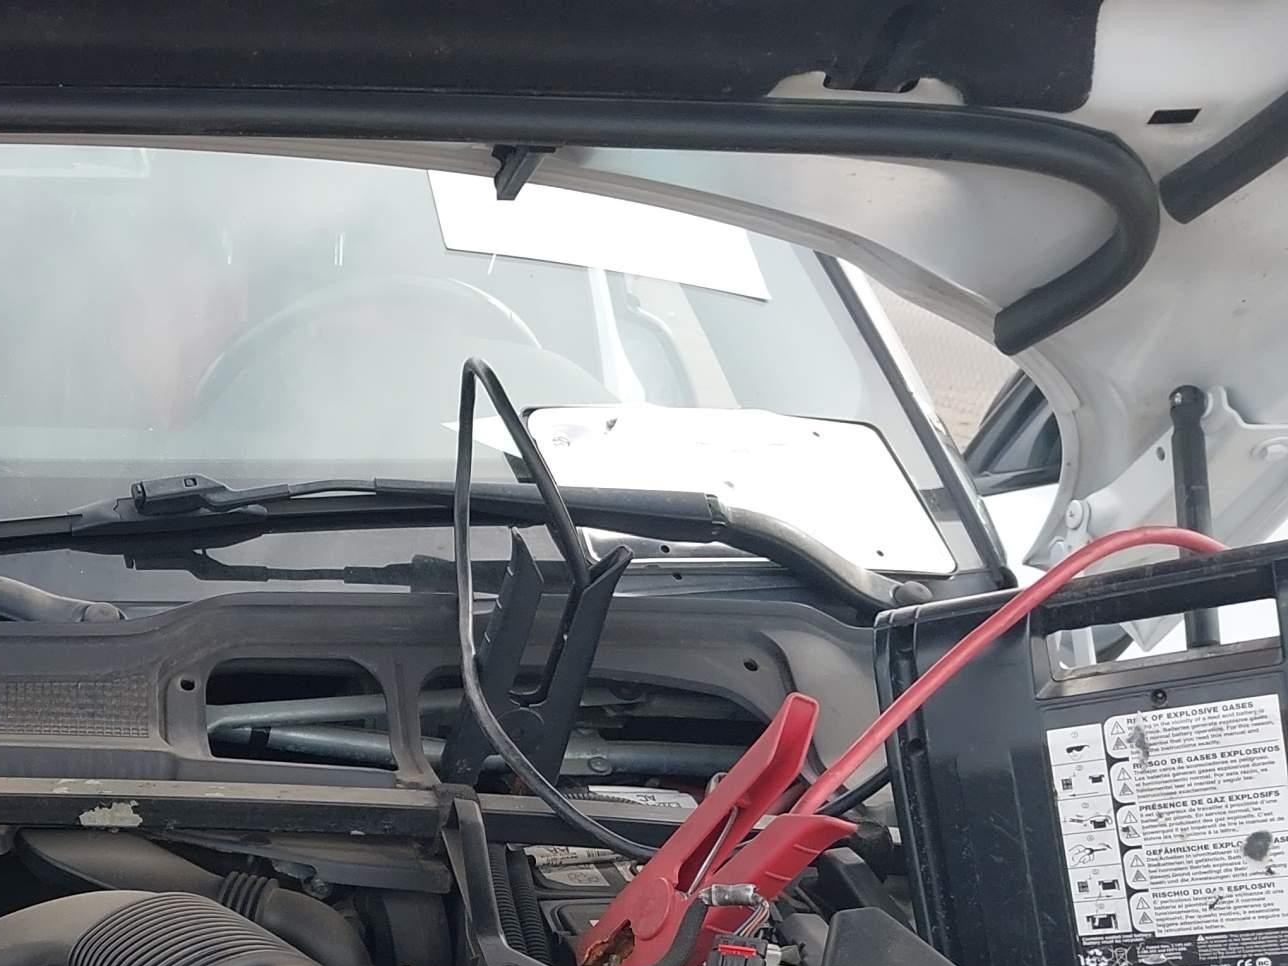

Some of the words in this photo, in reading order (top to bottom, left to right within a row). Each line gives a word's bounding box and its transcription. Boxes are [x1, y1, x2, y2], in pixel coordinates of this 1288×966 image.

[1127, 716, 1148, 724] RIK
[1167, 707, 1218, 719] EXPLOSIVE
[1222, 702, 1253, 712] GASES
[1133, 759, 1167, 769] RISGO
[1170, 757, 1183, 765] DE
[1186, 753, 1217, 763] GASES
[1220, 745, 1280, 759] EXPLOSIVOS
[1139, 800, 1188, 811] PRÉSENCE
[1191, 798, 1203, 806] DE
[1206, 796, 1226, 804] GAZ
[1228, 790, 1280, 802] EXPLOSIFS
[1145, 843, 1209, 856] GEFÄHRLICHE
[1152, 890, 1191, 899] RISCHIO
[1227, 882, 1276, 892] ESPLOSIVI
